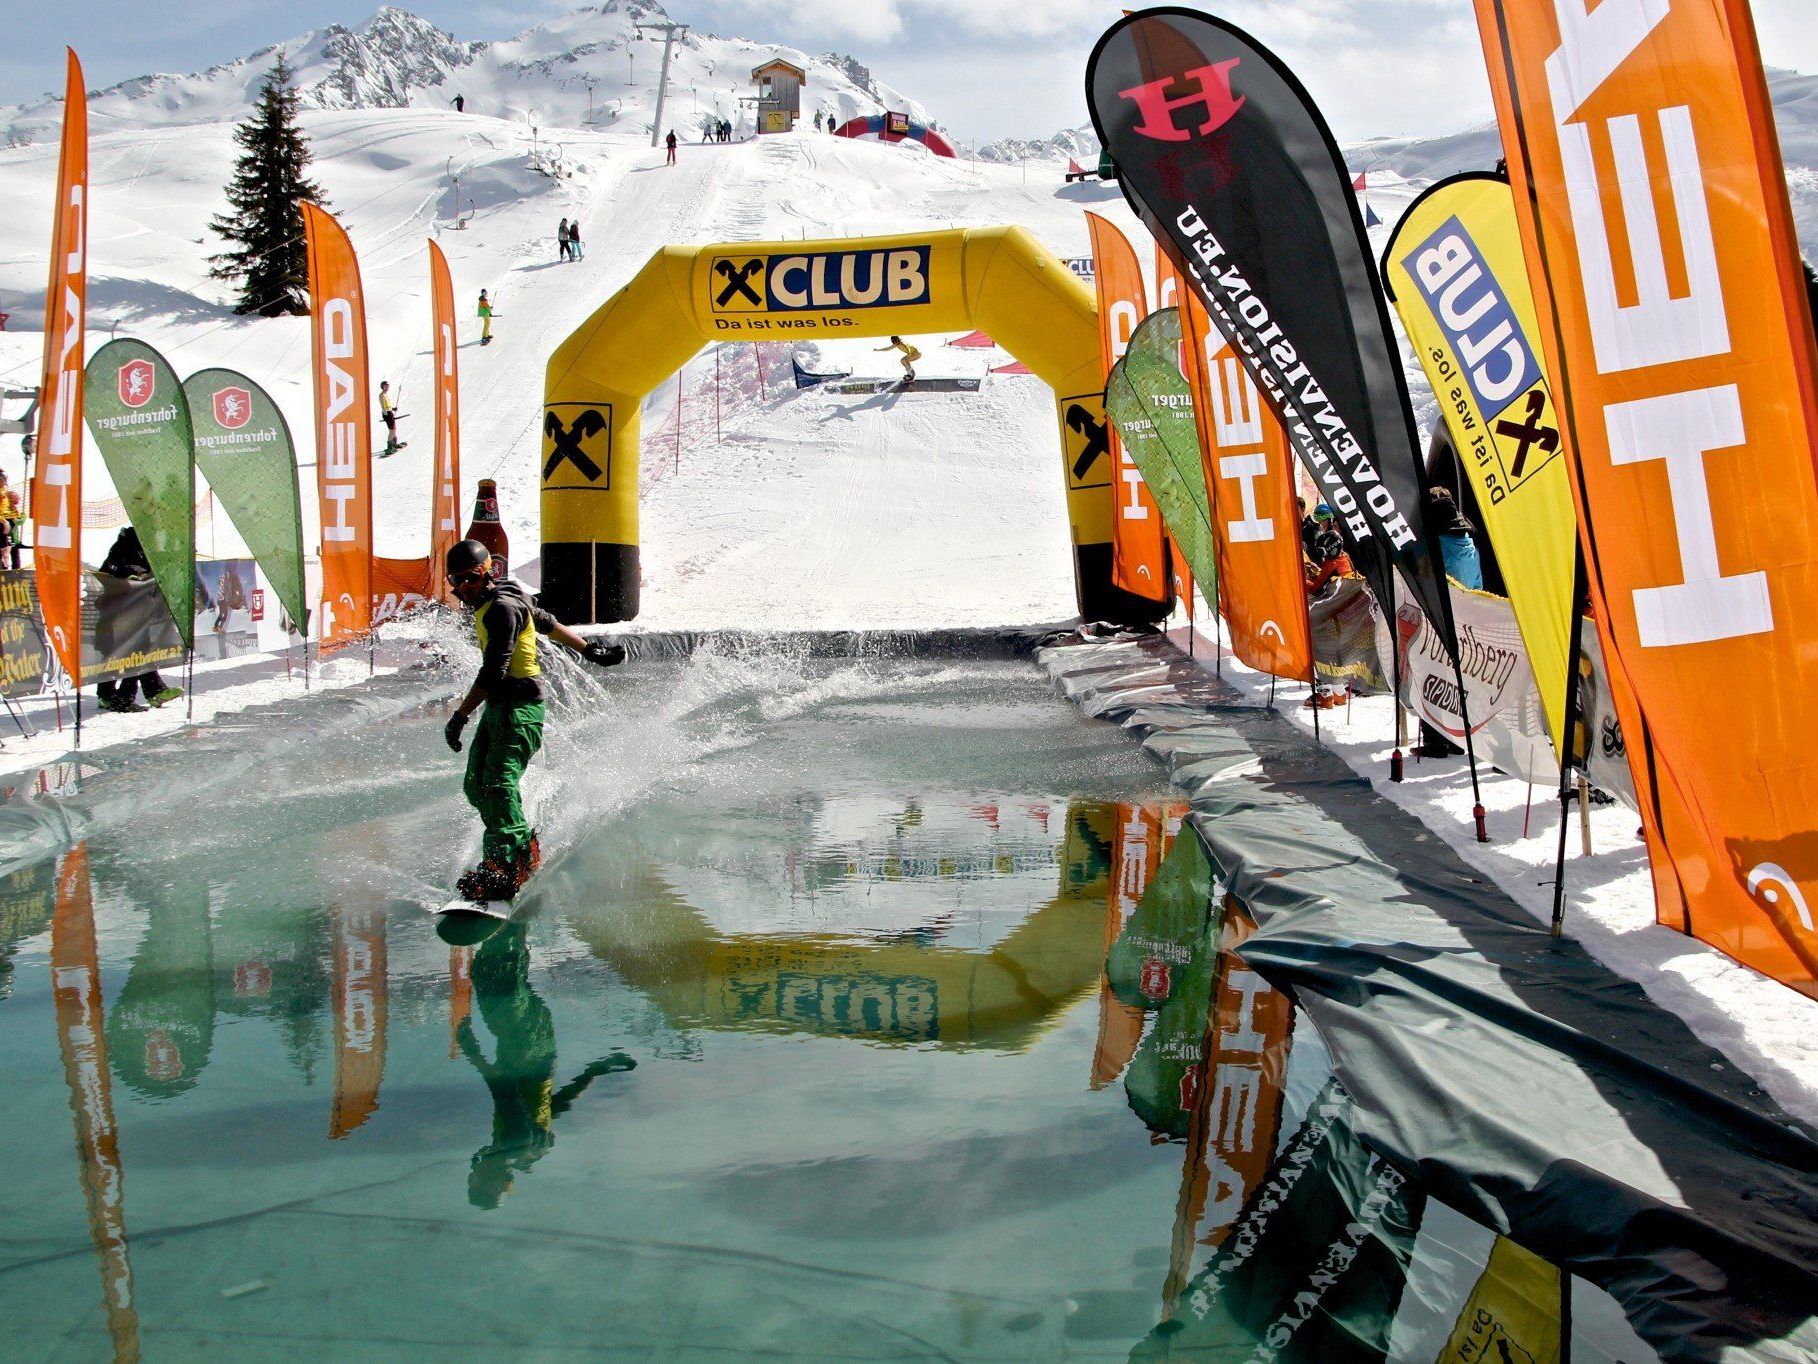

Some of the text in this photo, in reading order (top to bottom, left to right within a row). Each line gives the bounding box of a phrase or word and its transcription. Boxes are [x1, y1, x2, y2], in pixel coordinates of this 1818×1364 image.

[1068, 260, 1094, 274] CLU
[770, 250, 925, 307] CLUB
[715, 316, 859, 330] Da ist was los.
